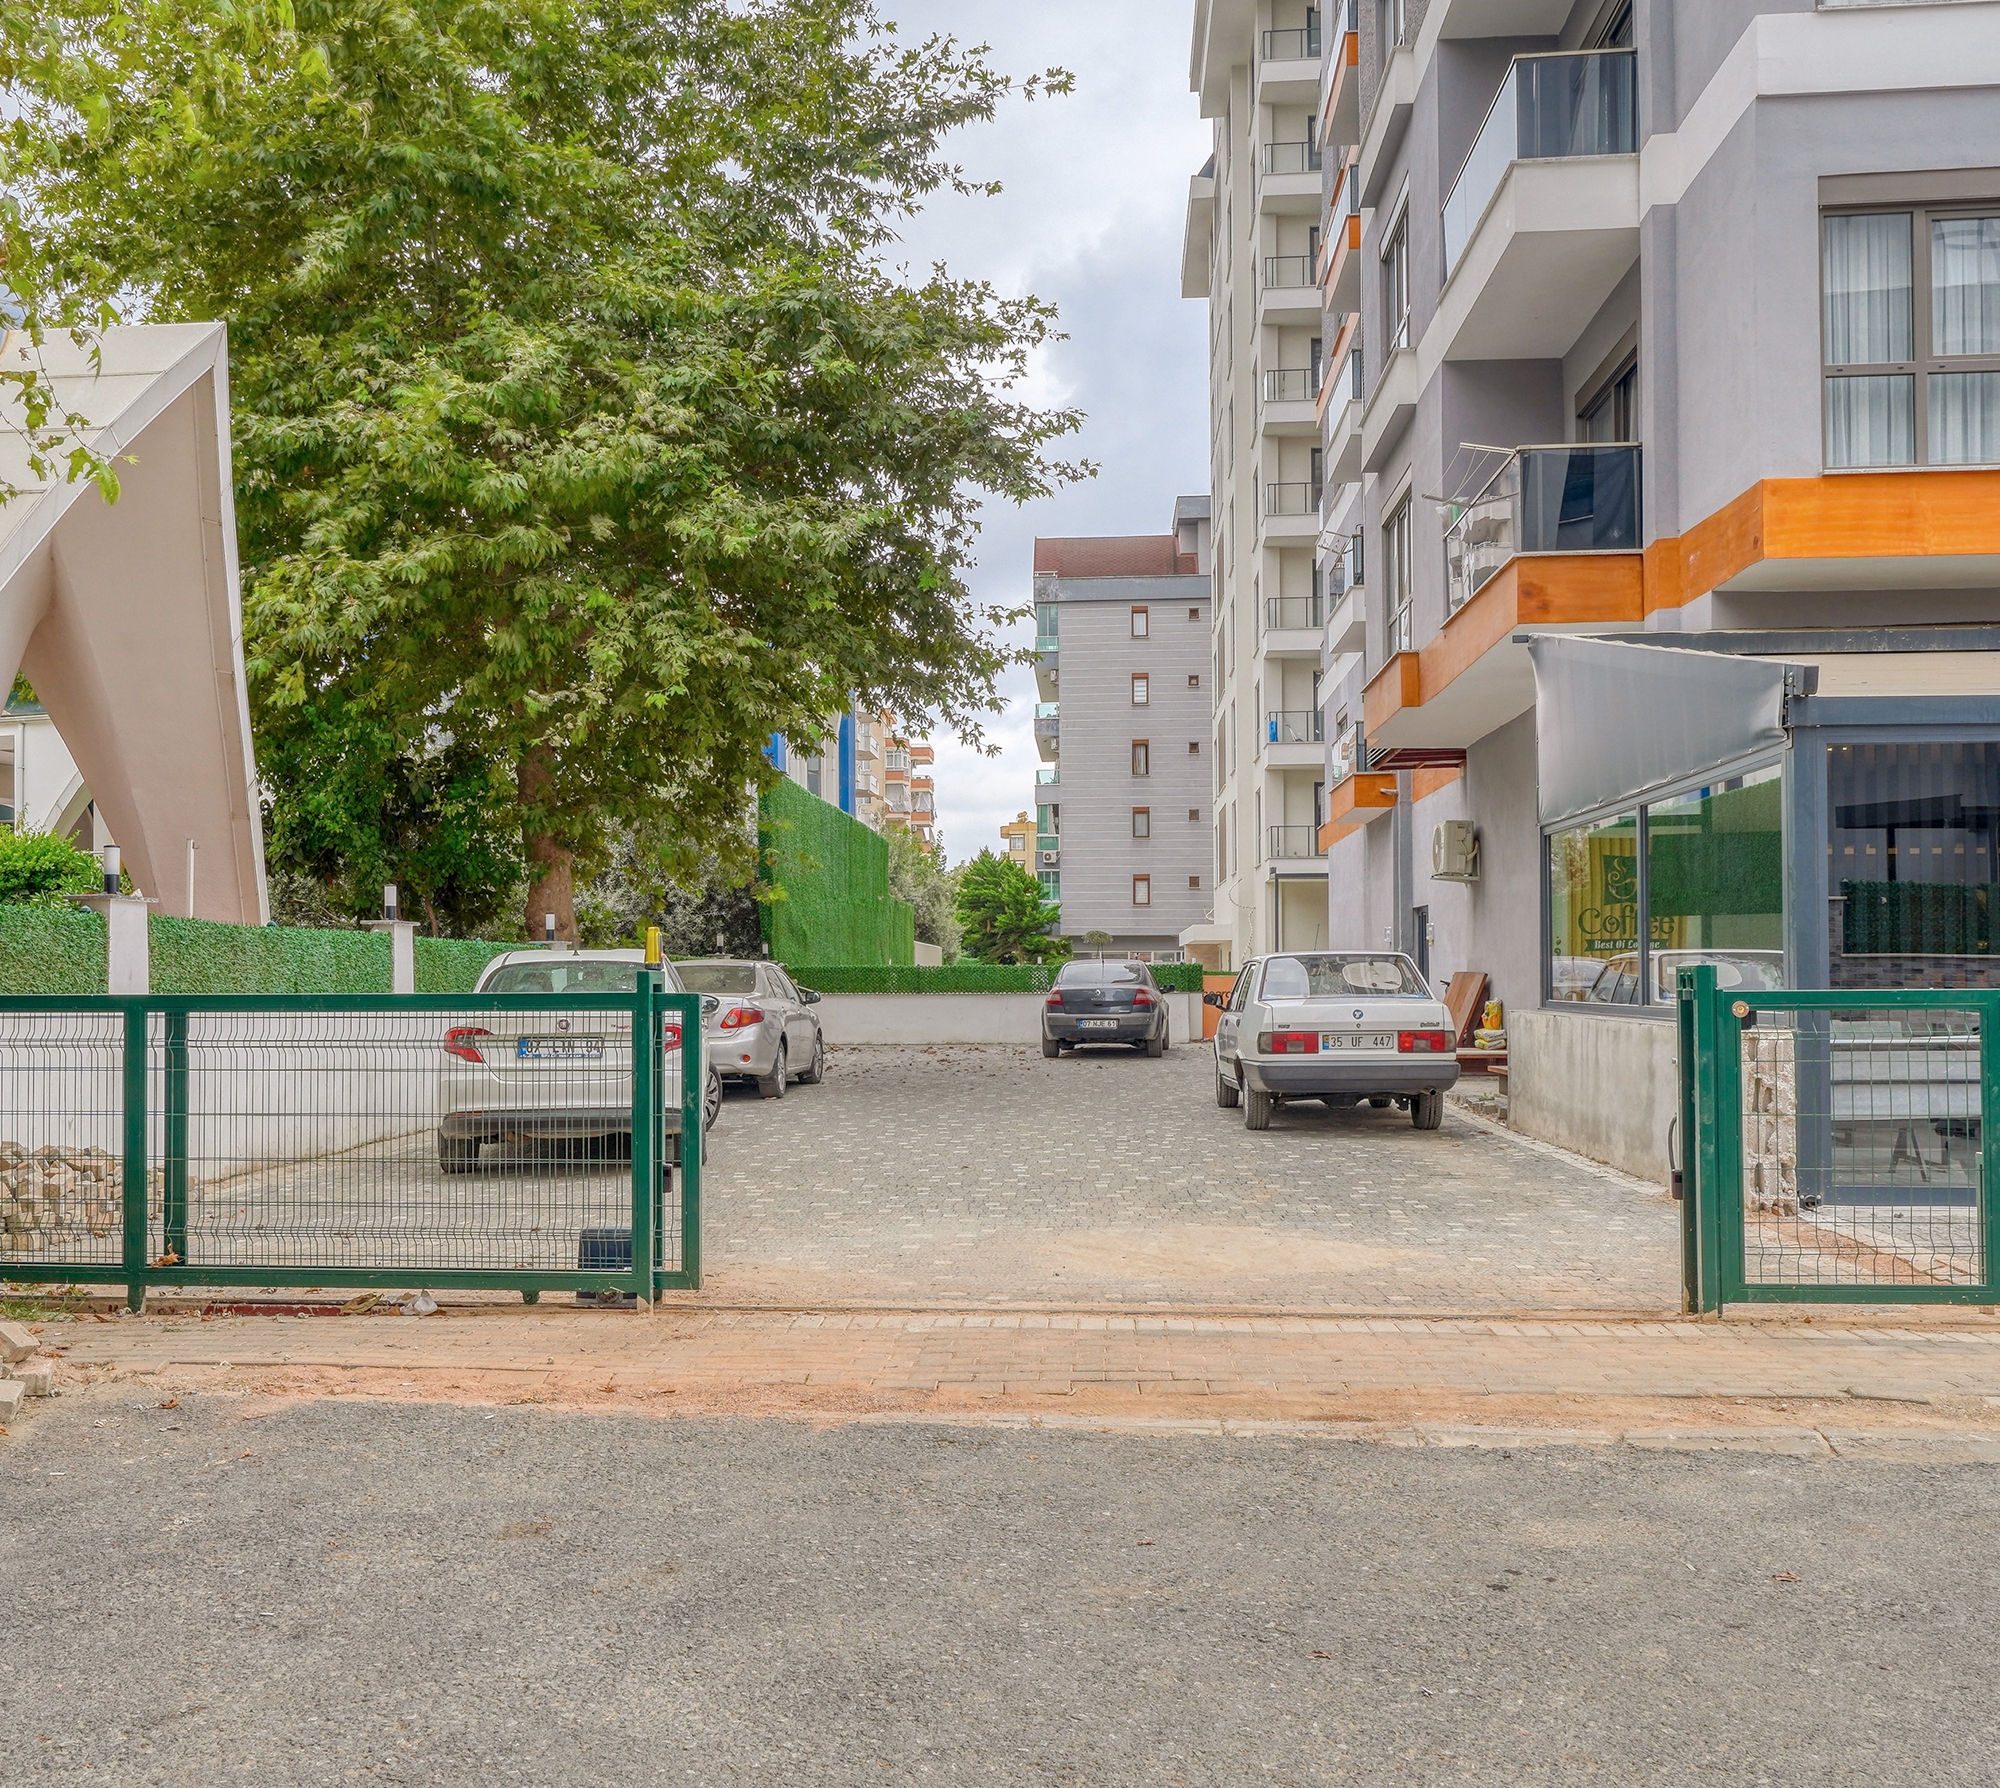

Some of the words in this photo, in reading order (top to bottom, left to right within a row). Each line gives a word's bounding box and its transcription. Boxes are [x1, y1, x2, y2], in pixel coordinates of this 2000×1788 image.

[1594, 940, 1613, 950] Best
[1615, 940, 1626, 949] Of
[1627, 940, 1660, 950] Loge
[1330, 1037, 1343, 1048] 35
[1351, 1037, 1363, 1048] UF
[1373, 1036, 1391, 1047] 447
